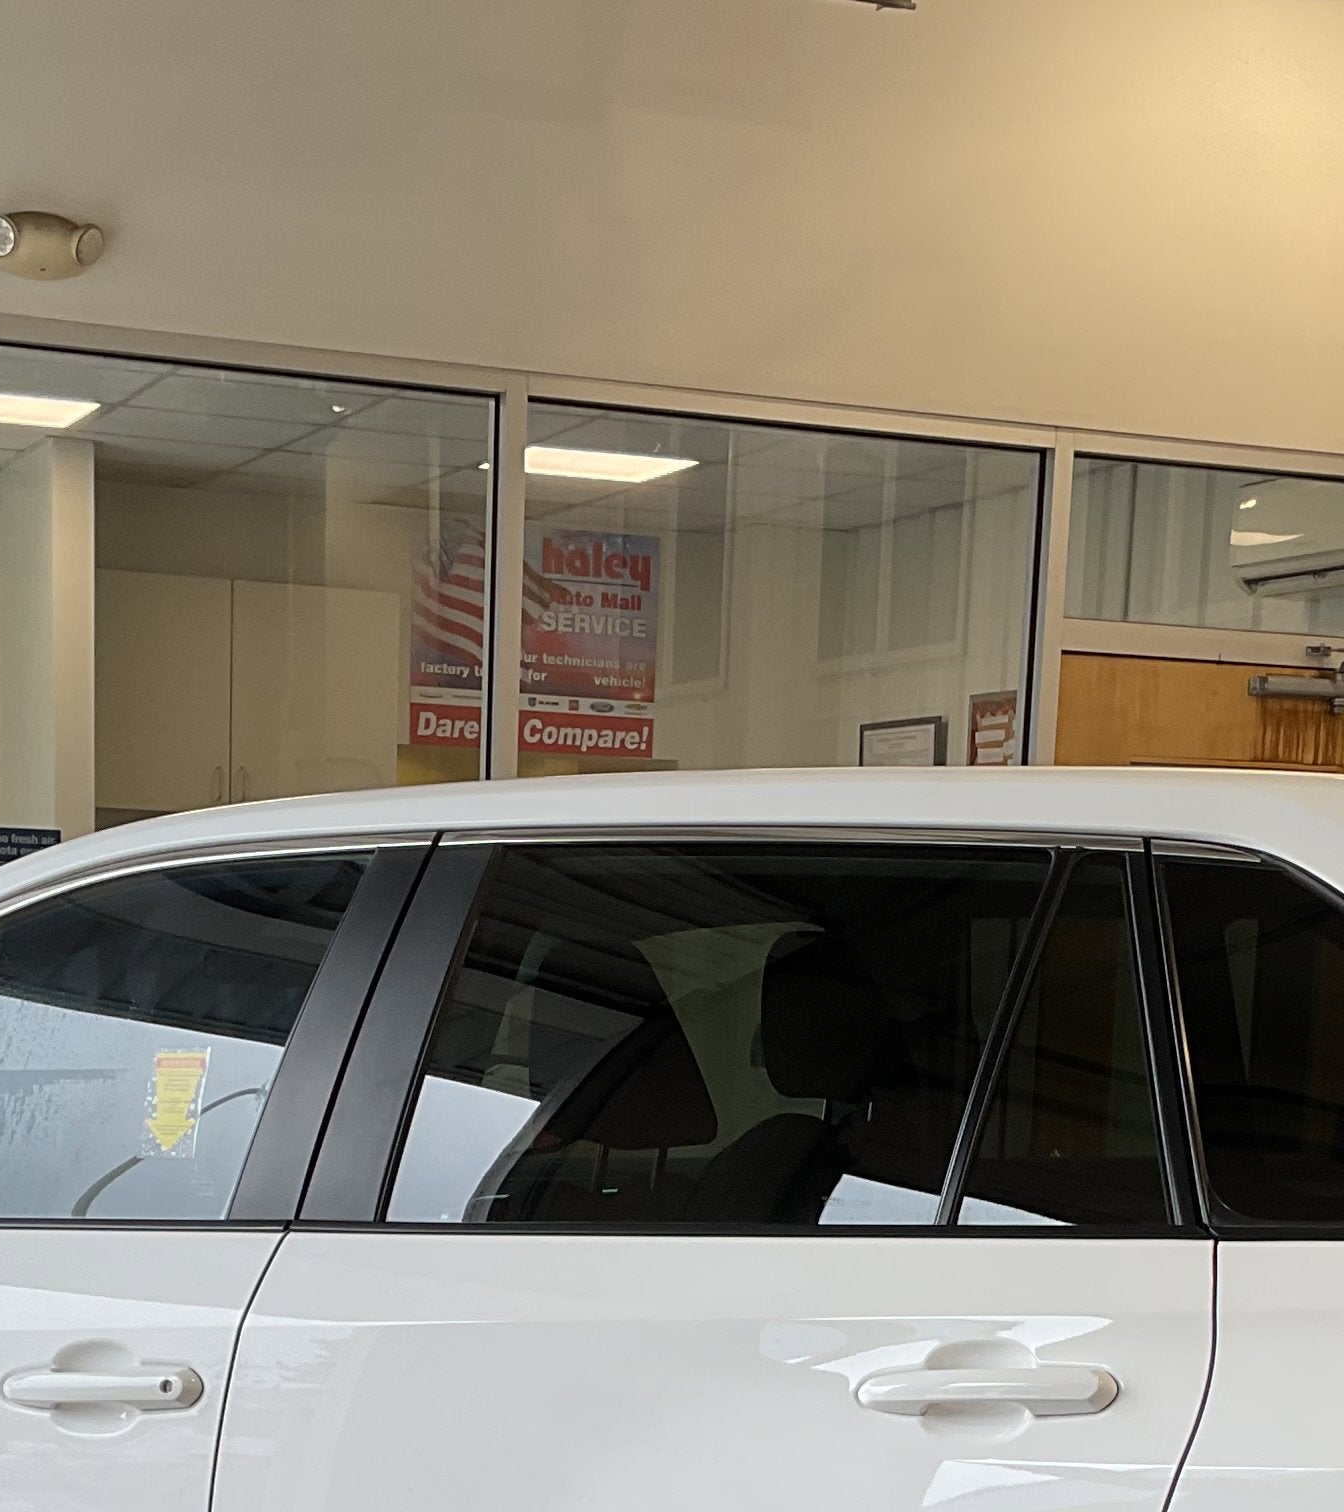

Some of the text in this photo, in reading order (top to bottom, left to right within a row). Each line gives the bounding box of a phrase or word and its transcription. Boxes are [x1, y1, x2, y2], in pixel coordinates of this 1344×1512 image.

[542, 537, 652, 592] haley
[600, 592, 642, 611] Mall
[540, 611, 647, 638] SERVICE
[543, 652, 621, 669] technicians
[421, 662, 470, 678] factory
[528, 669, 548, 683] for
[594, 675, 646, 689] vehicle!
[417, 711, 649, 752] Dare Compare!
[11, 833, 39, 845] fresh
